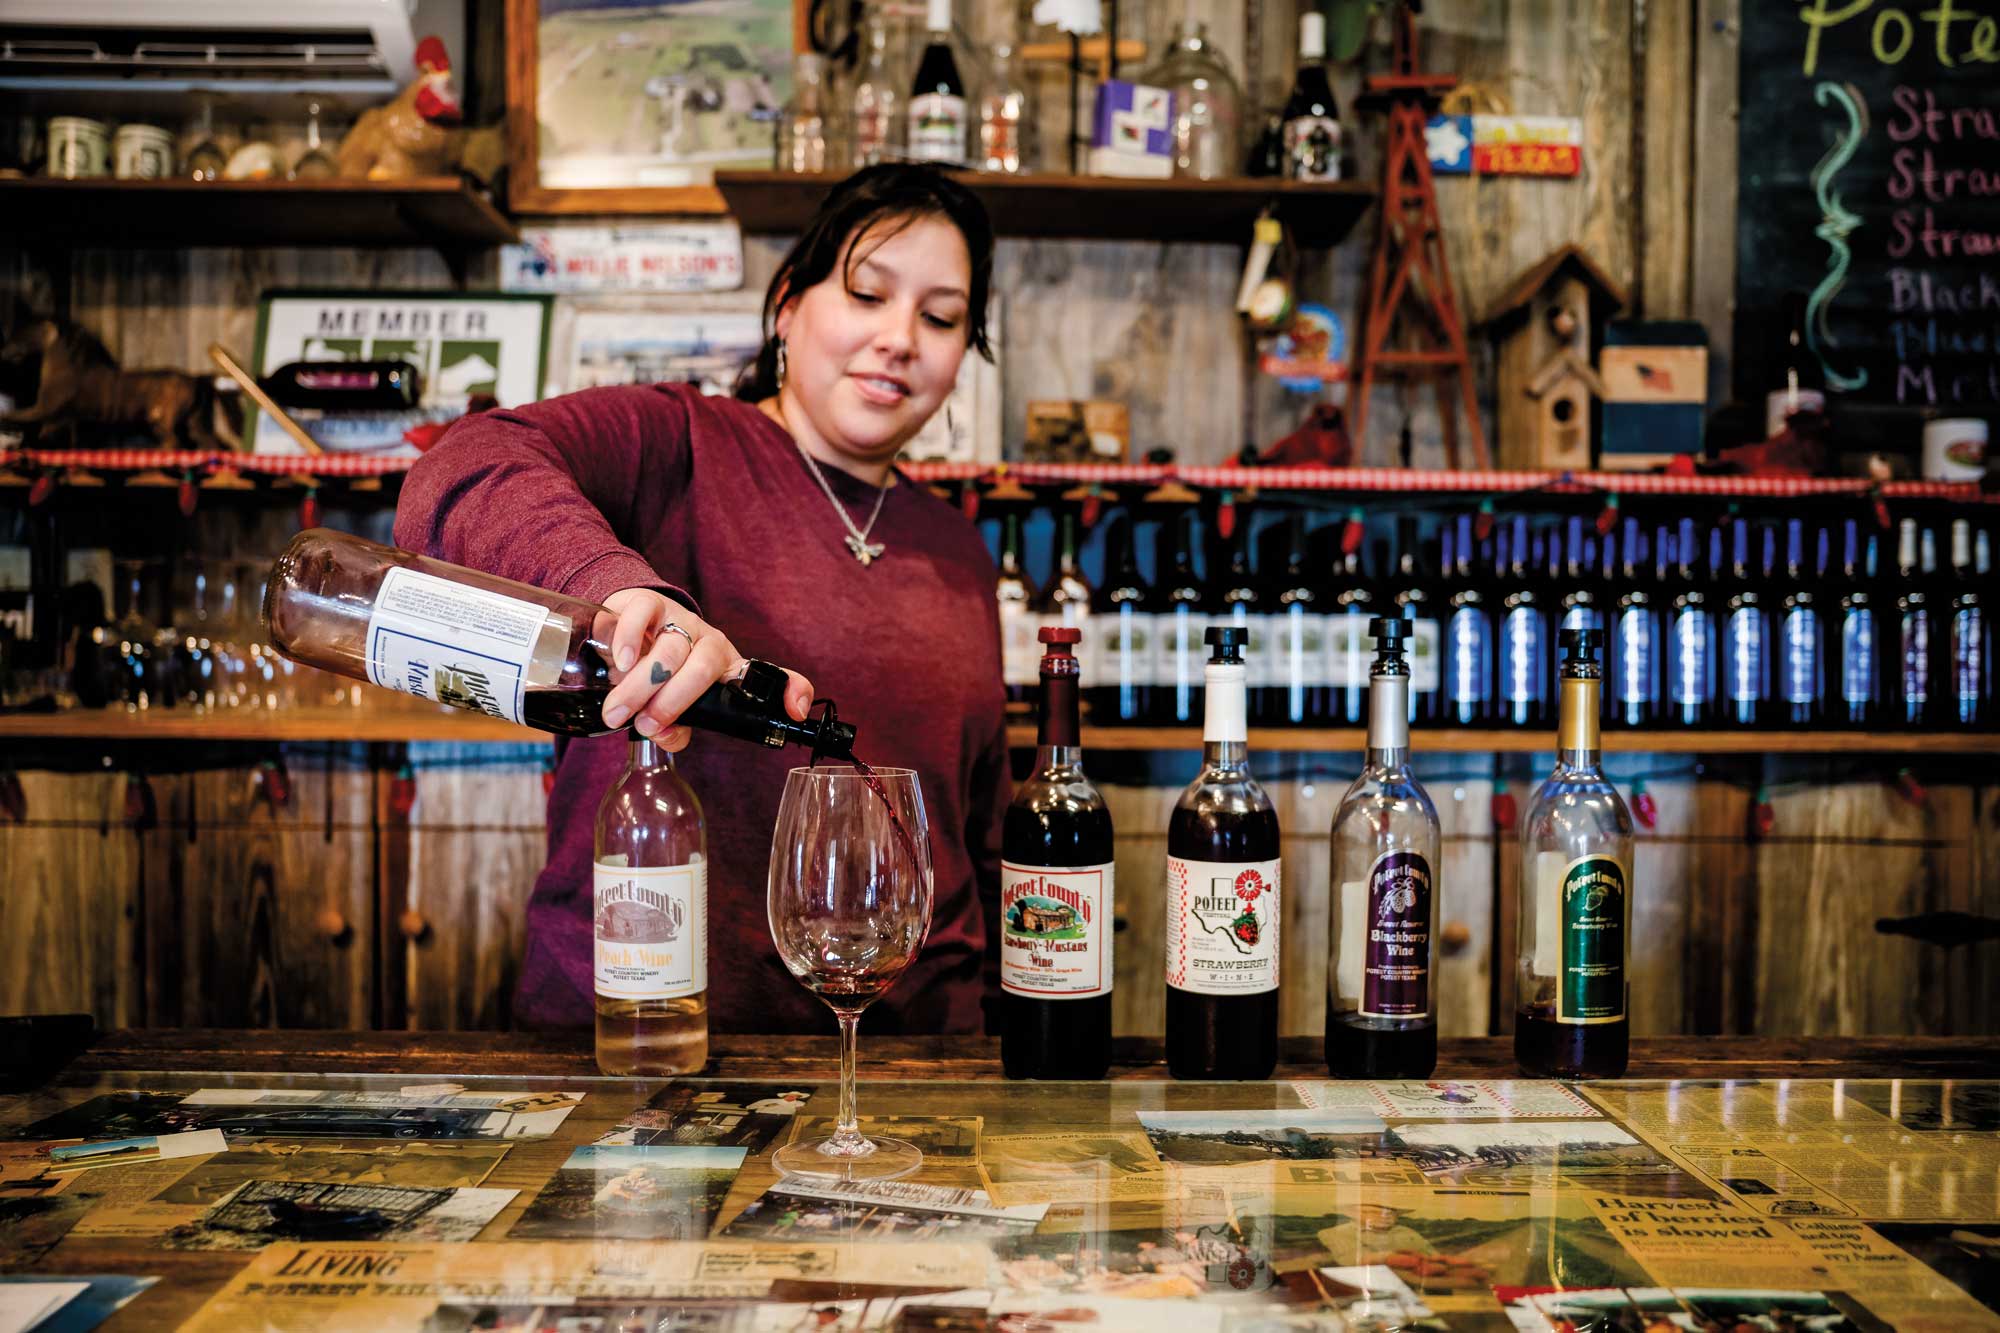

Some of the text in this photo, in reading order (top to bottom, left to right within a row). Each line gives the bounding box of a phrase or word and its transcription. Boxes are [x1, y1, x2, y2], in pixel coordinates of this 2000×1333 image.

[317, 308, 488, 334] MEMBER
[1194, 895, 1237, 911] POTEET
[1371, 929, 1427, 943] Blackberry
[1386, 944, 1415, 956] Wine
[1028, 953, 1054, 968] Wine
[1192, 958, 1268, 970] STRAWBERRY
[1596, 1198, 1721, 1210] Harvest
[1610, 1210, 1765, 1224] of berries
[1618, 1225, 1774, 1238] is slowed
[275, 1249, 406, 1276] LIVING
